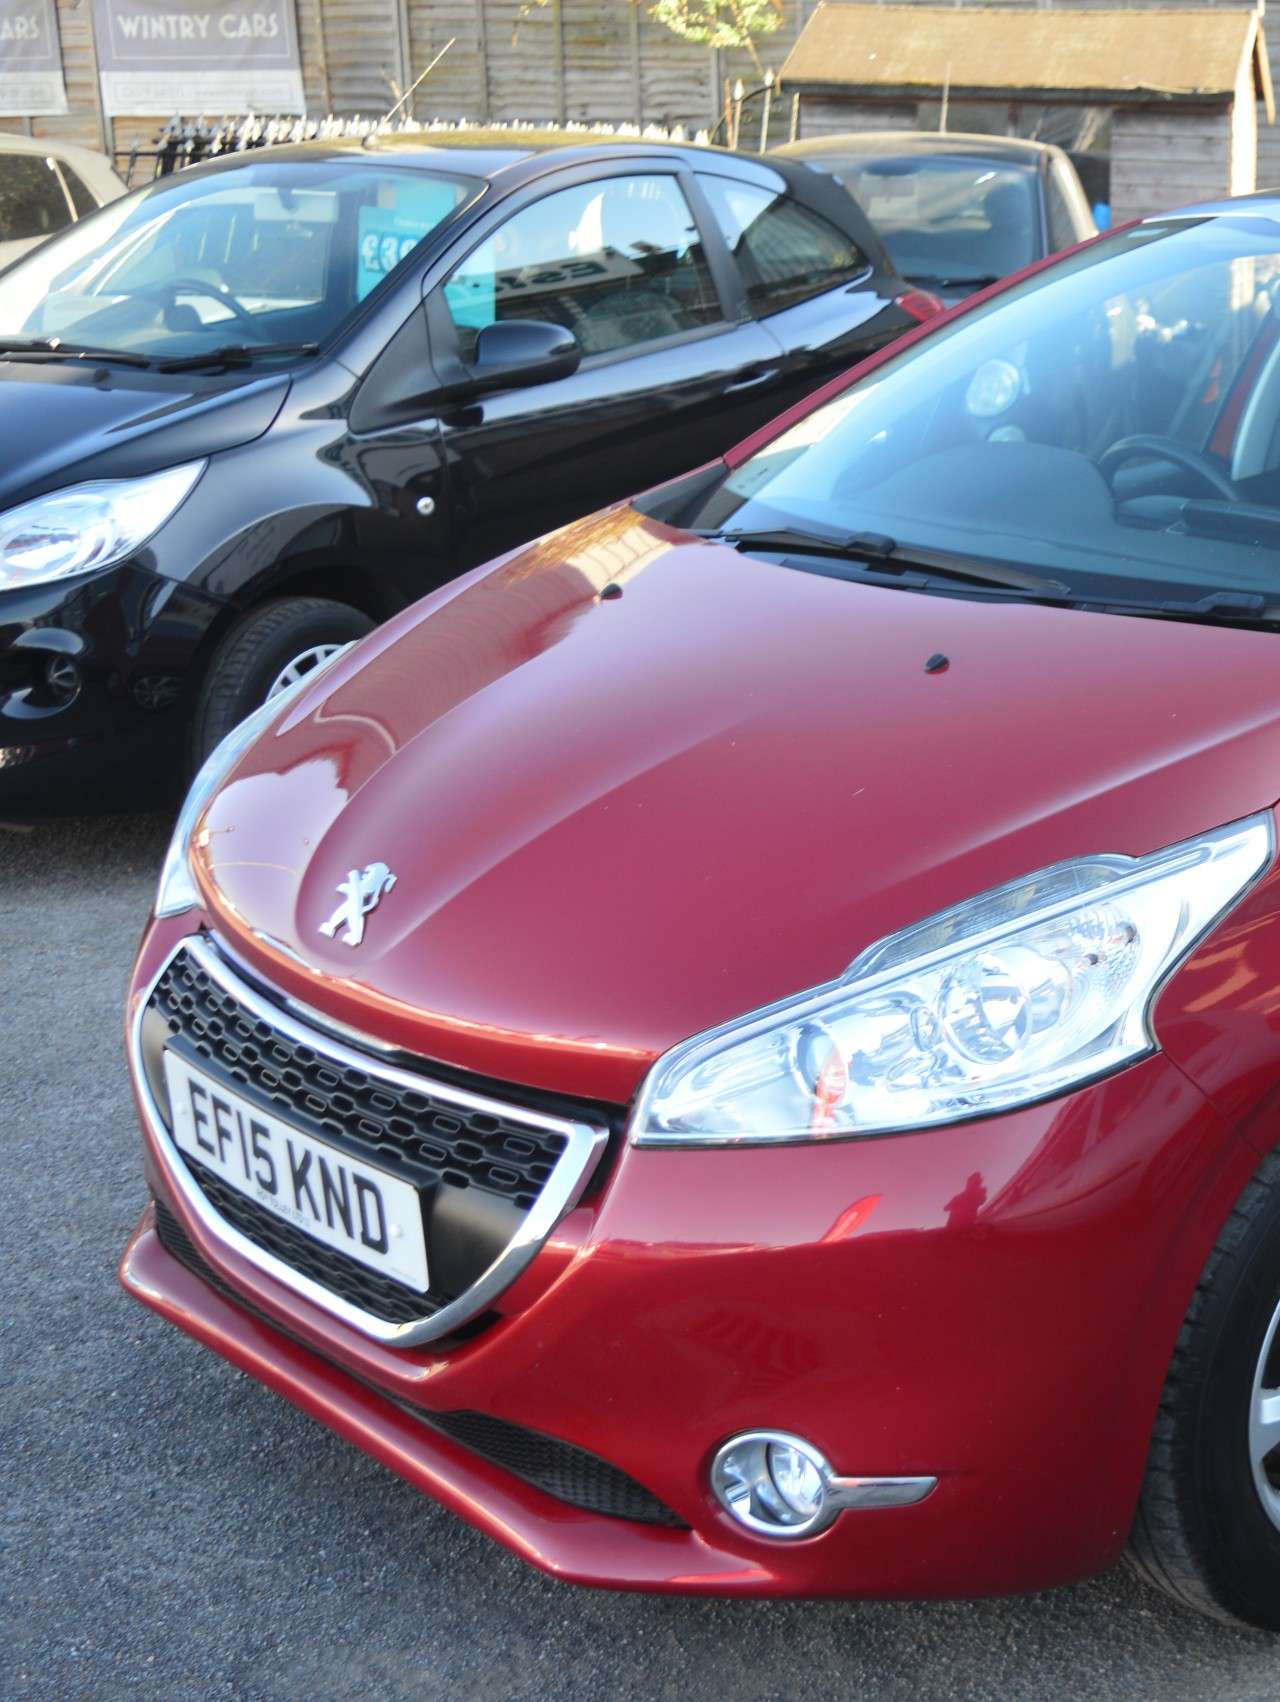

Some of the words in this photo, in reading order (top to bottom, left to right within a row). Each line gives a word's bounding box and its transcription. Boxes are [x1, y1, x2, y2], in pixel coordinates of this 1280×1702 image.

[117, 14, 209, 40] WINTRY
[218, 13, 279, 39] CARS
[188, 1077, 278, 1195] EF15
[286, 1138, 389, 1255] KND
